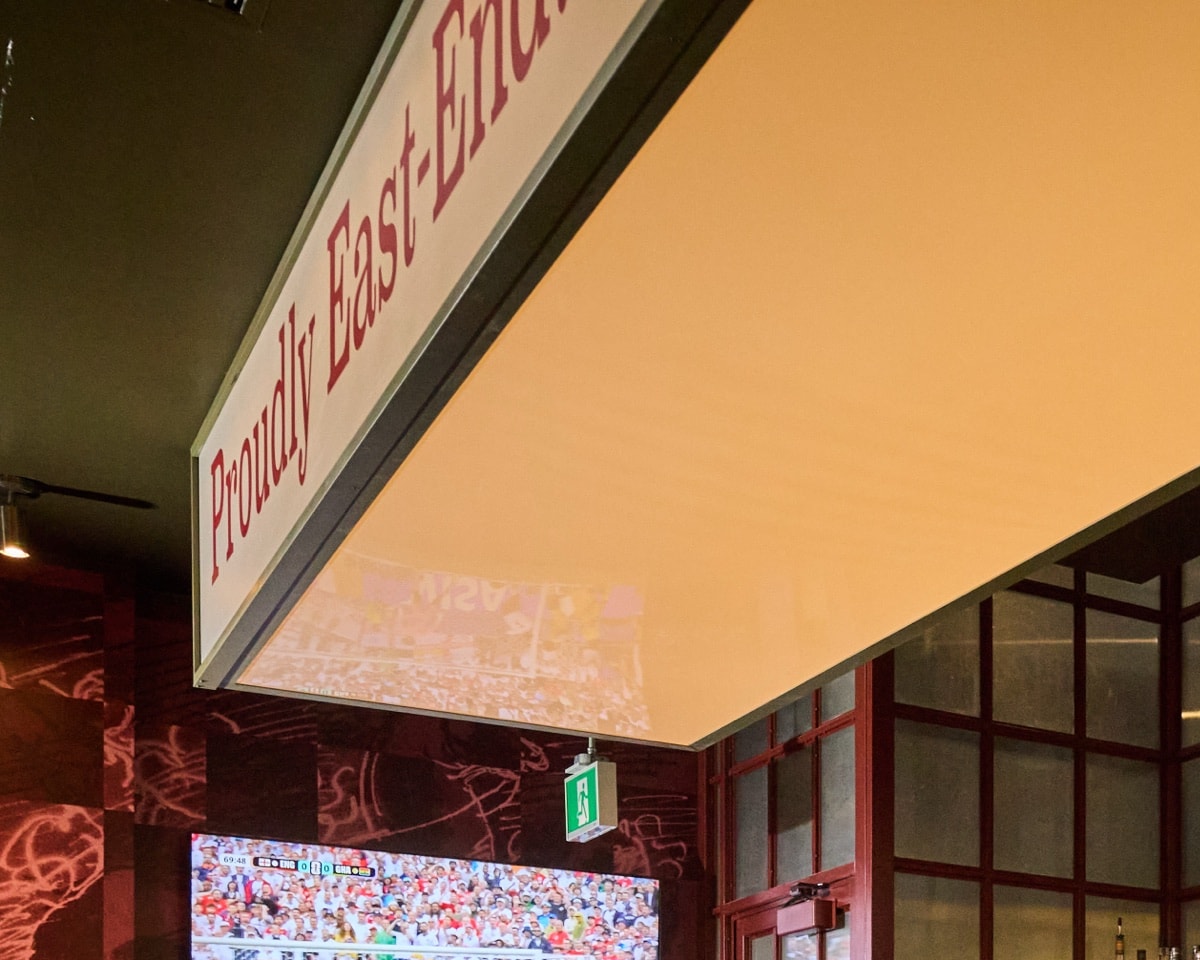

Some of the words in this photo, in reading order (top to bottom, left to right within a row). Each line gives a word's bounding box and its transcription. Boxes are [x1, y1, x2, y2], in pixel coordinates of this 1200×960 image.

[210, 302, 316, 585] Proudly
[326, 0, 567, 395] East-En
[223, 855, 247, 865] 69:48
[279, 859, 296, 870] ENG
